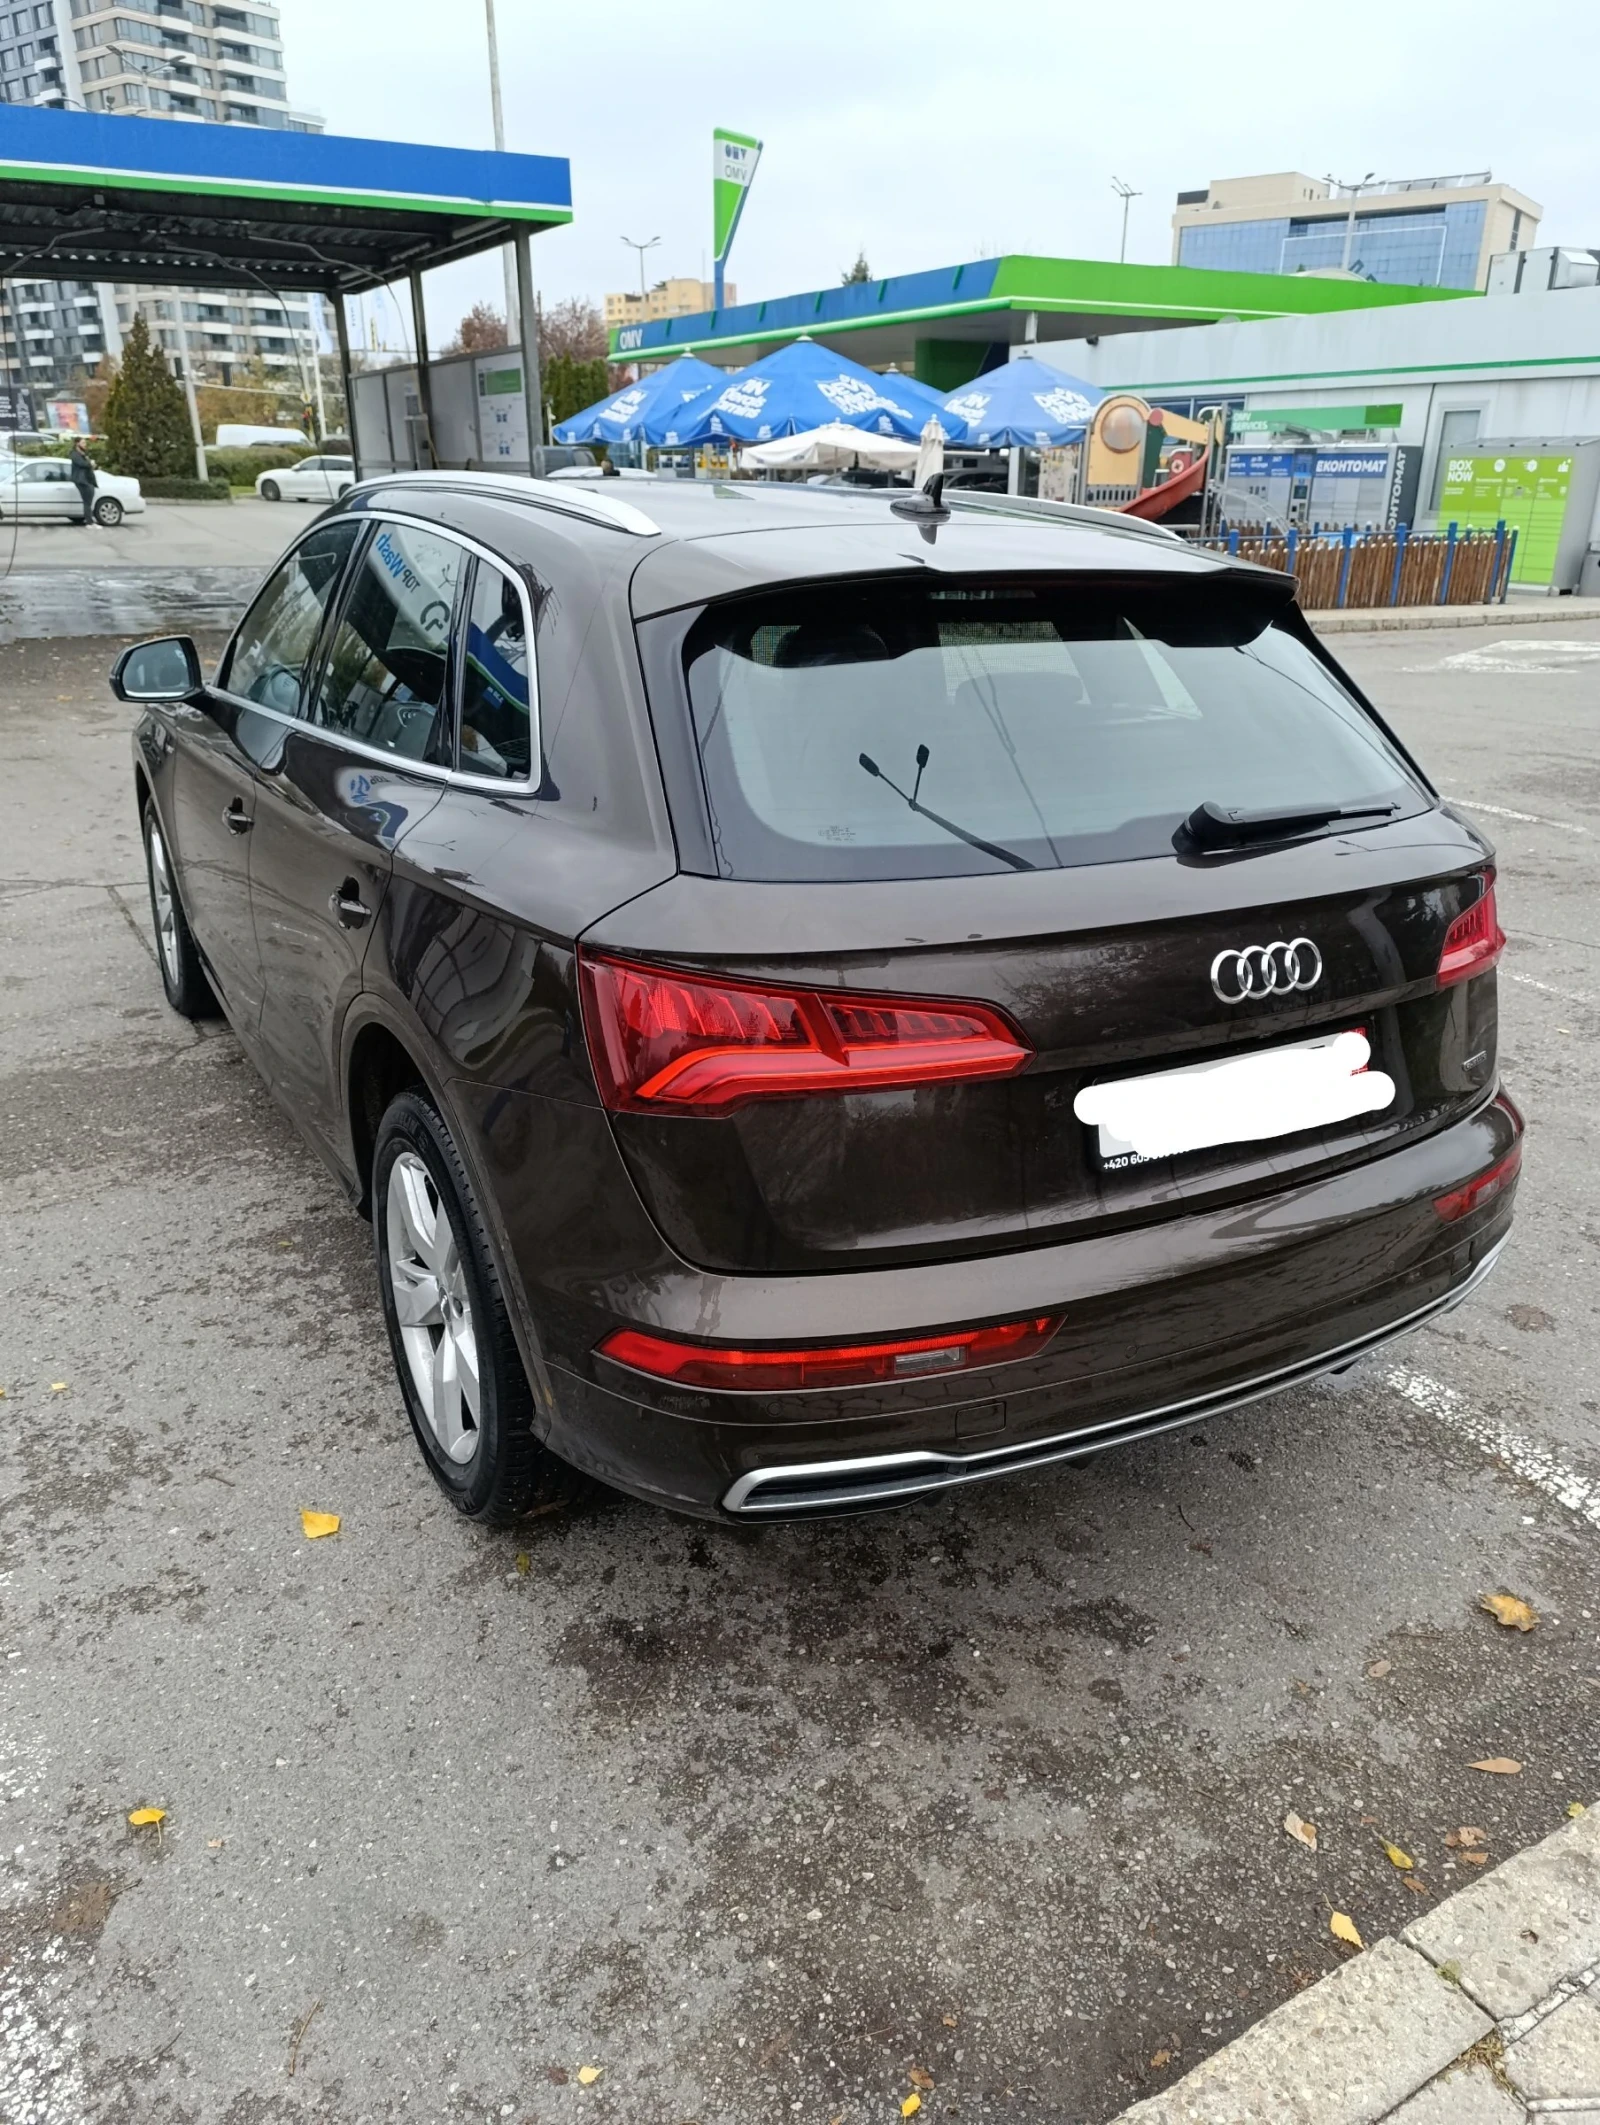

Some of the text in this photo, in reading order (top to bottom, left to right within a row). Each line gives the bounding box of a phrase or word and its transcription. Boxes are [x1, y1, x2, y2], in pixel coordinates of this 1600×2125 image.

[725, 165, 748, 181] OMV
[620, 329, 643, 350] OMV
[1449, 460, 1473, 470] BOX
[1447, 471, 1473, 482] NOW
[1387, 449, 1407, 530] ОНТОМАТ
[1103, 1156, 1129, 1169] +420
